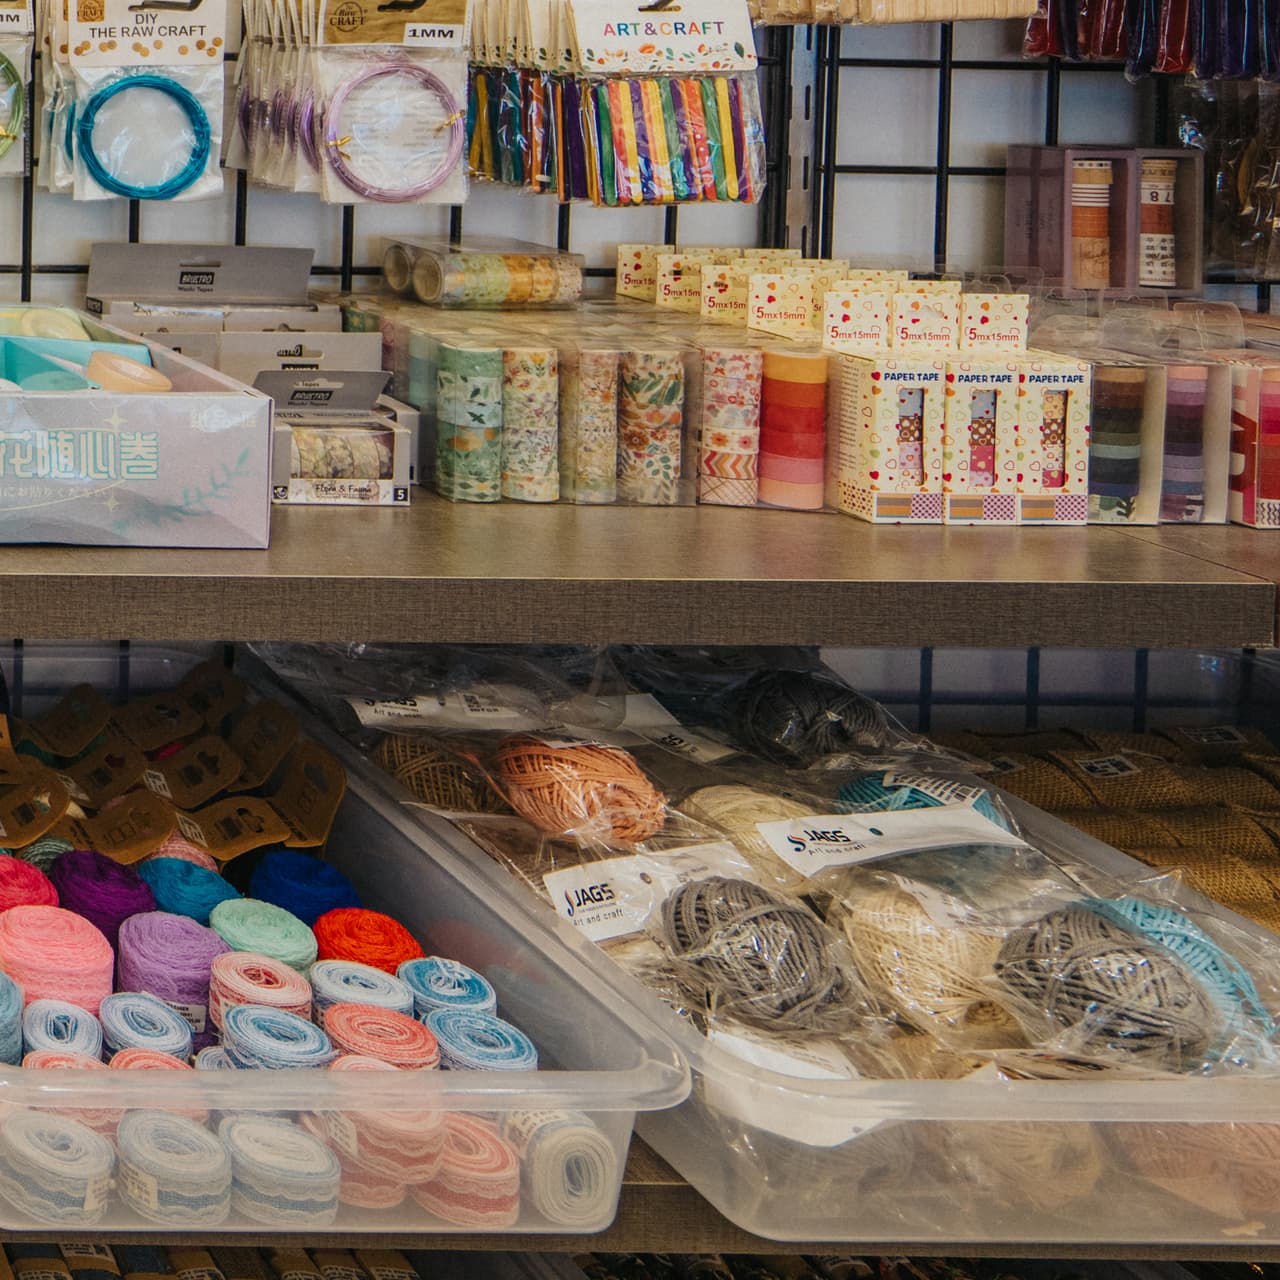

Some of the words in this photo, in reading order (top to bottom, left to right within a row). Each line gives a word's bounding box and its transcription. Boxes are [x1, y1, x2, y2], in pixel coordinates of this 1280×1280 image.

[135, 13, 158, 25] DIY
[330, 16, 366, 27] CRAFT
[89, 27, 117, 39] THE
[121, 26, 154, 38] RAW
[158, 25, 207, 37] CRAFT
[408, 28, 454, 39] 1MM
[756, 306, 806, 320] 5mx15mm
[830, 325, 880, 339] 5mx15mm
[900, 327, 951, 340] 5mx15mm
[968, 328, 1019, 341] 5mx15mm
[884, 372, 915, 382] PAPER
[917, 372, 939, 382] TAPE
[958, 374, 988, 383] PAPER
[991, 374, 1013, 383] TAPE
[1029, 374, 1059, 384] PAPER
[1060, 374, 1084, 384] TAPE
[804, 830, 851, 842] JAGS
[575, 883, 616, 907] JAGS
